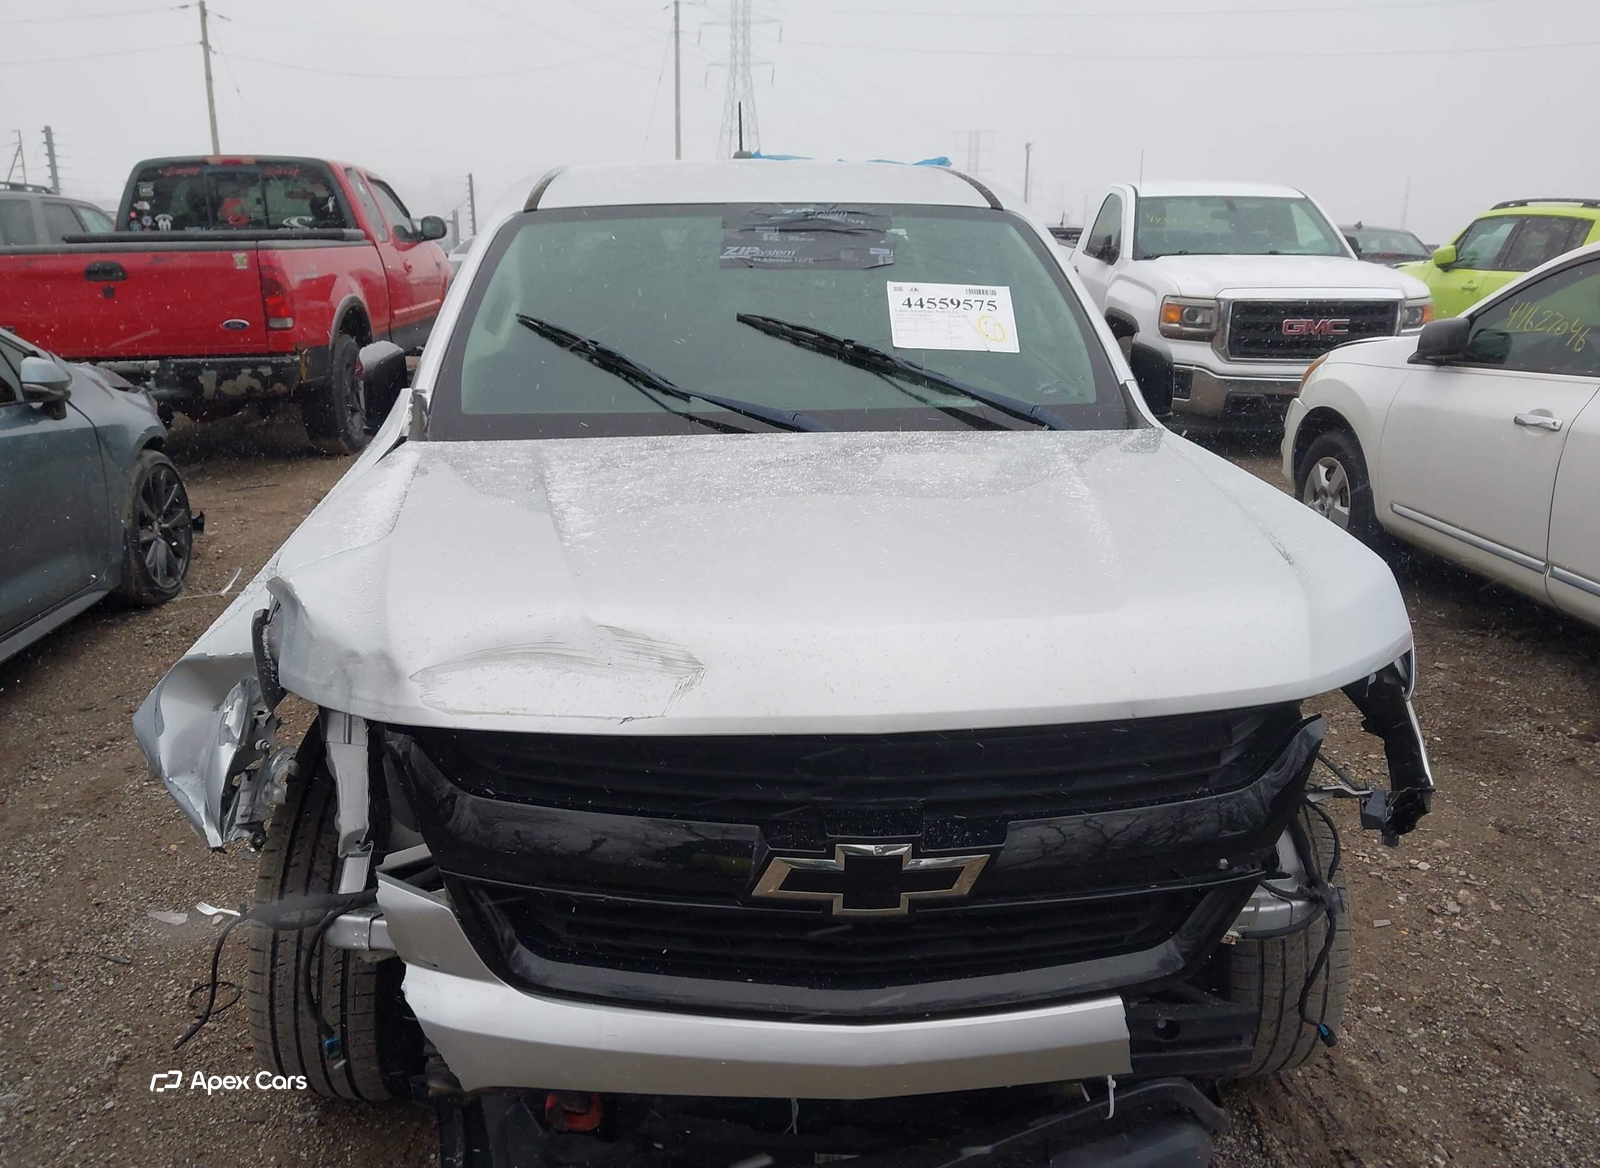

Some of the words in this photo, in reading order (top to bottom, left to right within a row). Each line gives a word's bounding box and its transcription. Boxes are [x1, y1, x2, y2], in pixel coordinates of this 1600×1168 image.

[901, 297, 998, 312] 44559575
[1282, 318, 1351, 336] GMC
[1506, 300, 1592, 353] 44627046
